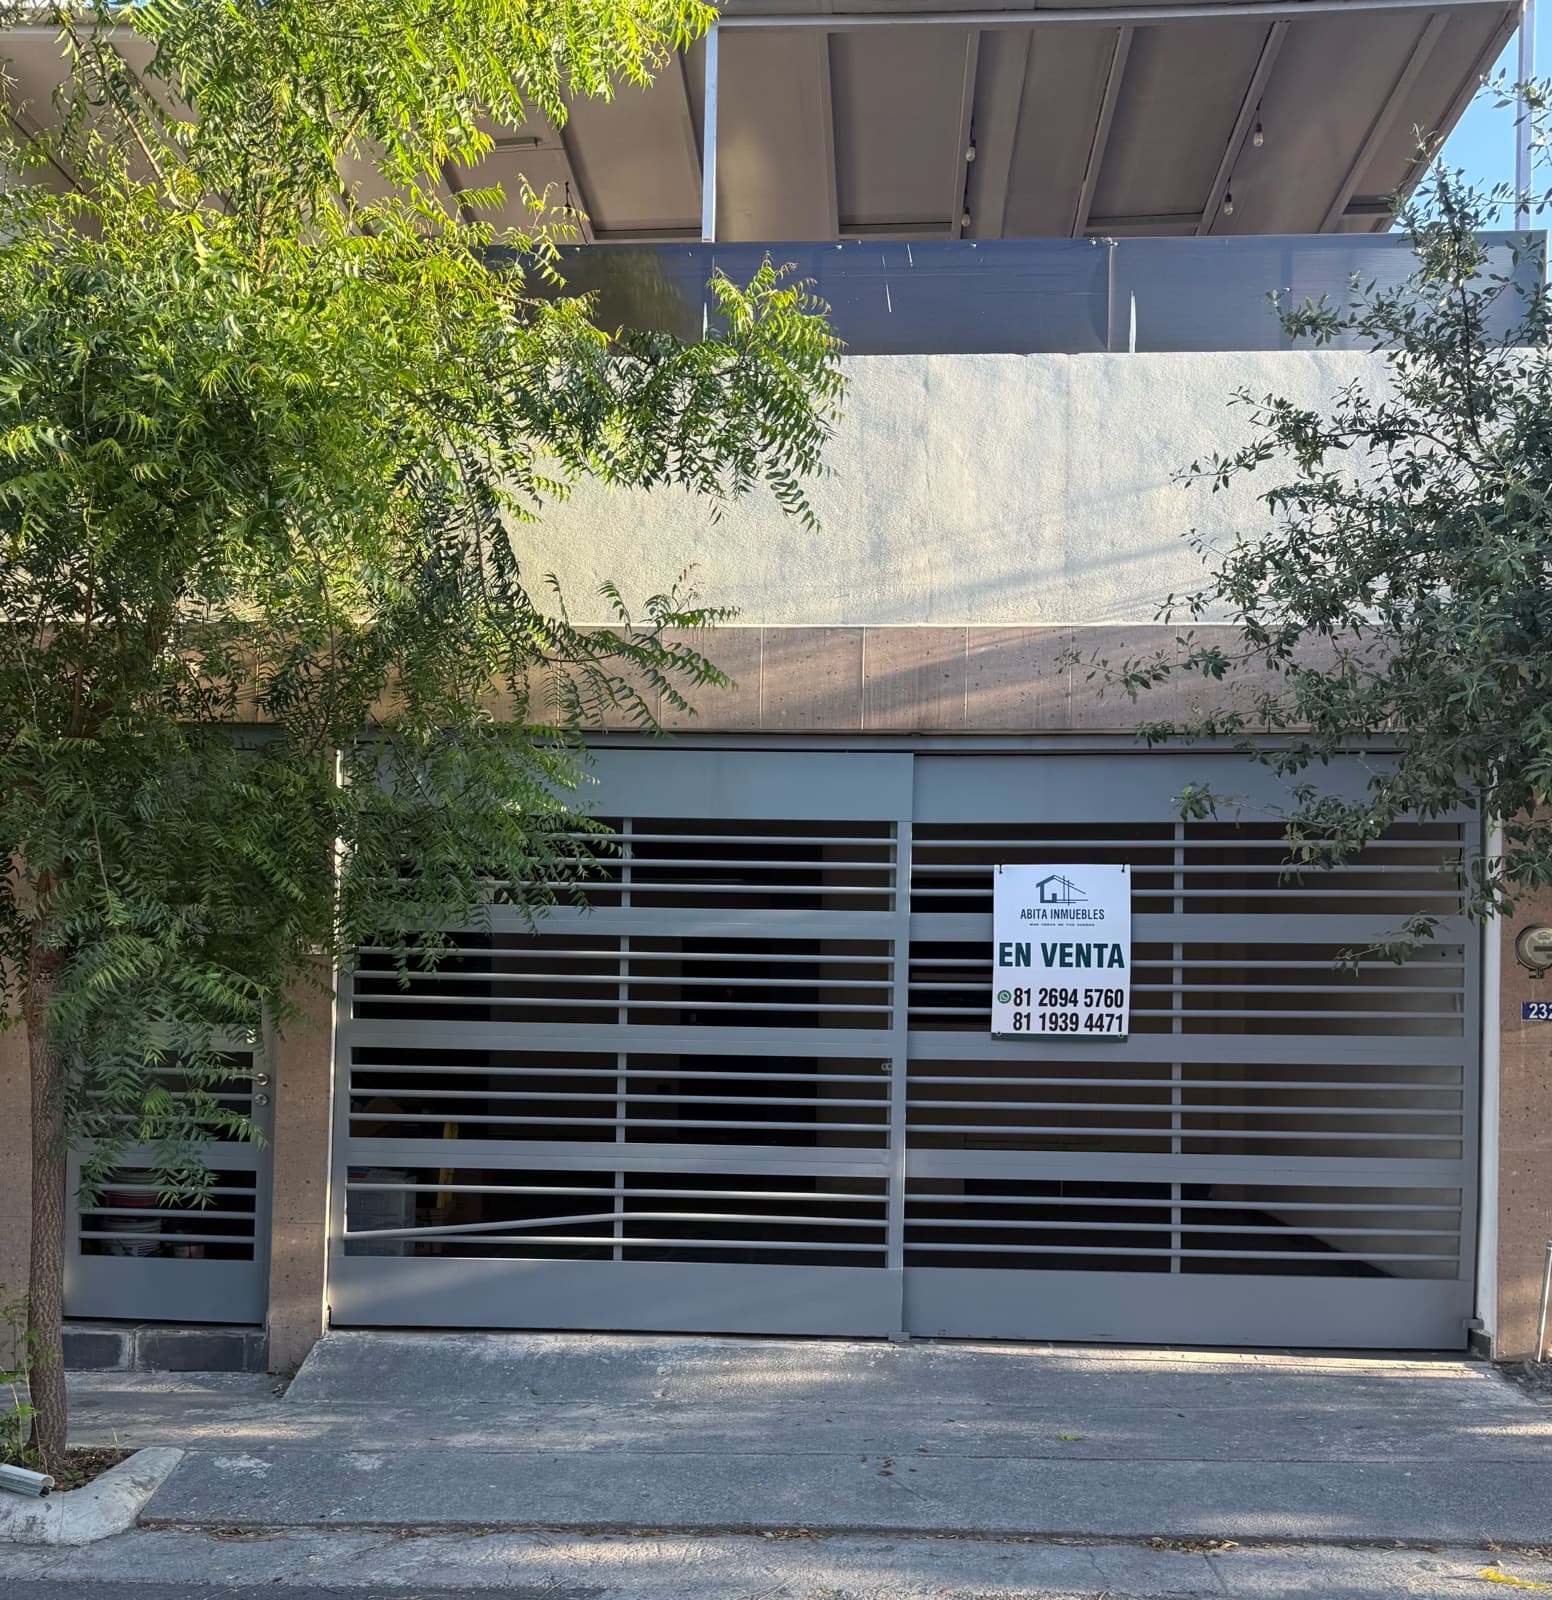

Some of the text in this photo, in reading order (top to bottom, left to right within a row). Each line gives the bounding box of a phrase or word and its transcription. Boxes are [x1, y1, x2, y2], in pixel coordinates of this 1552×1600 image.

[1020, 908, 1105, 920] ABITA INMUEBLES
[999, 942, 1125, 968] EN VENTA
[1013, 987, 1124, 1008] 81 2694 5760
[1013, 1012, 1123, 1033] 81 1939 4471
